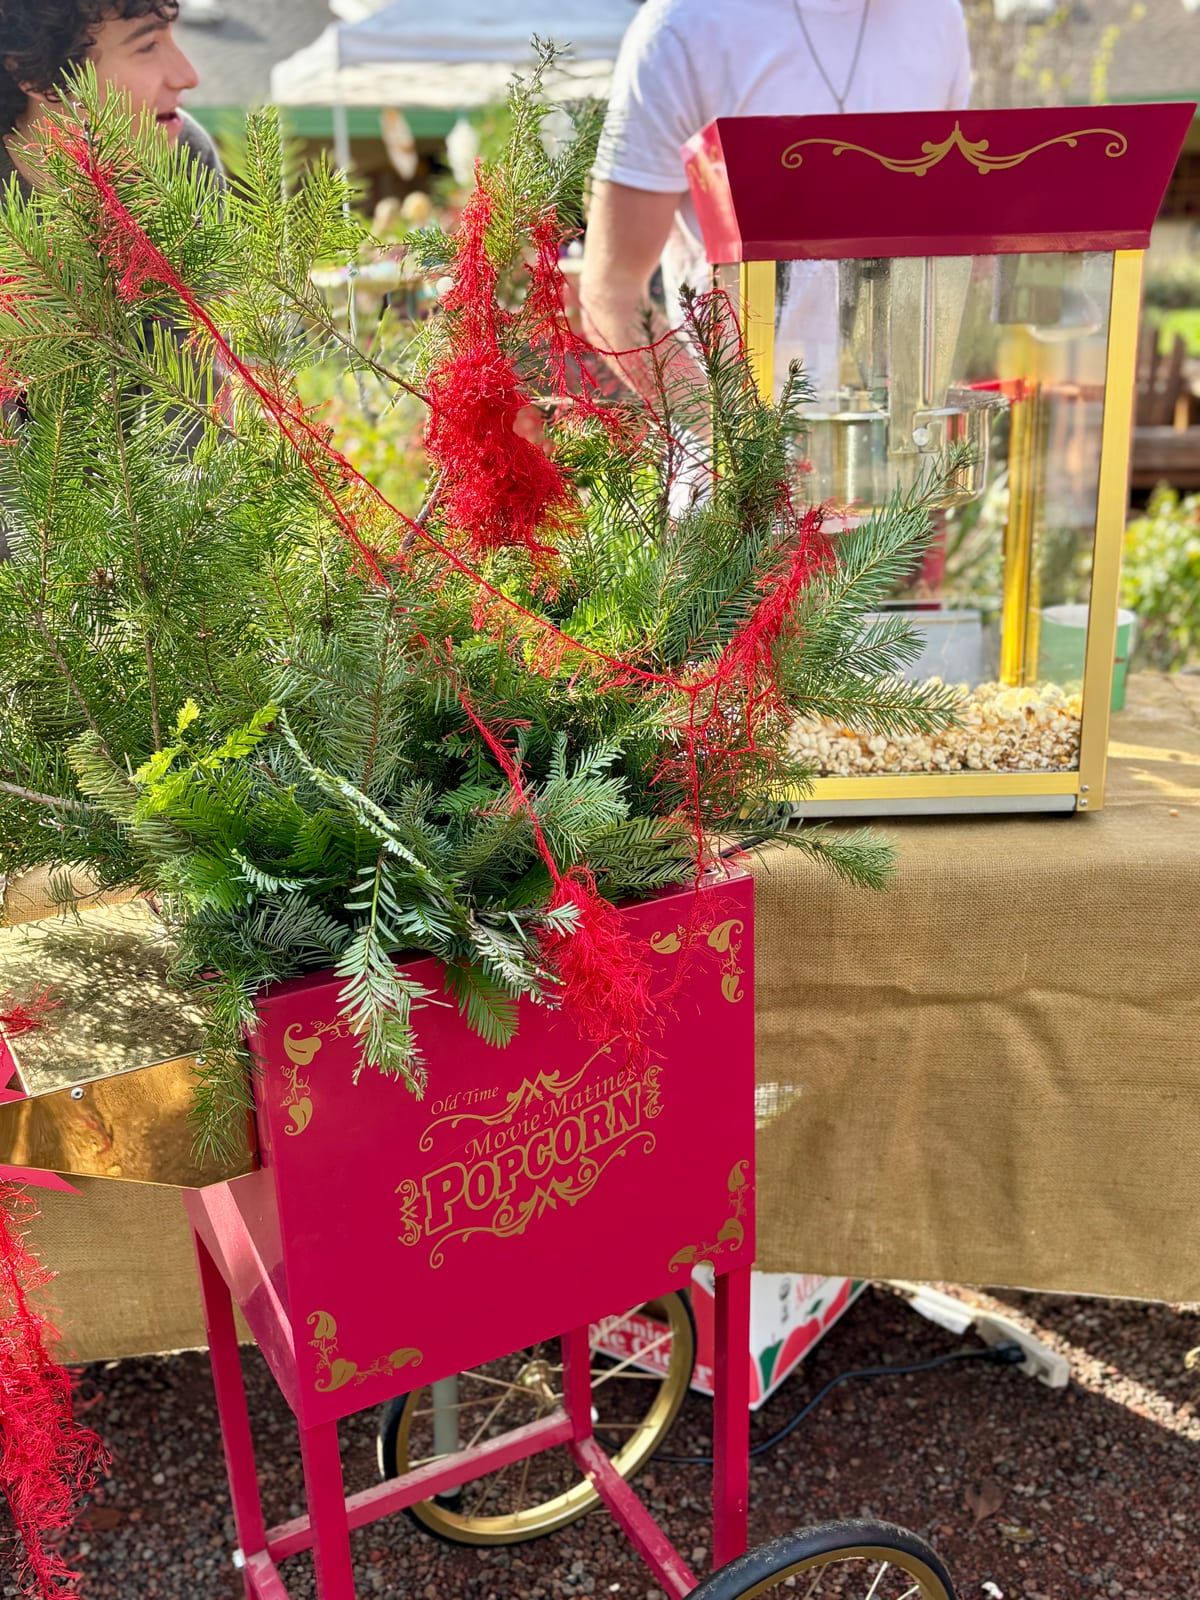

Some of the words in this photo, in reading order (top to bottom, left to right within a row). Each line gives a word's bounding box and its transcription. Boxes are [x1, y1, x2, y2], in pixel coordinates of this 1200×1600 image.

[431, 1091, 462, 1115] Old
[462, 1086, 500, 1106] Time
[421, 1081, 642, 1236] POPCORN
[464, 1112, 540, 1165] Movie
